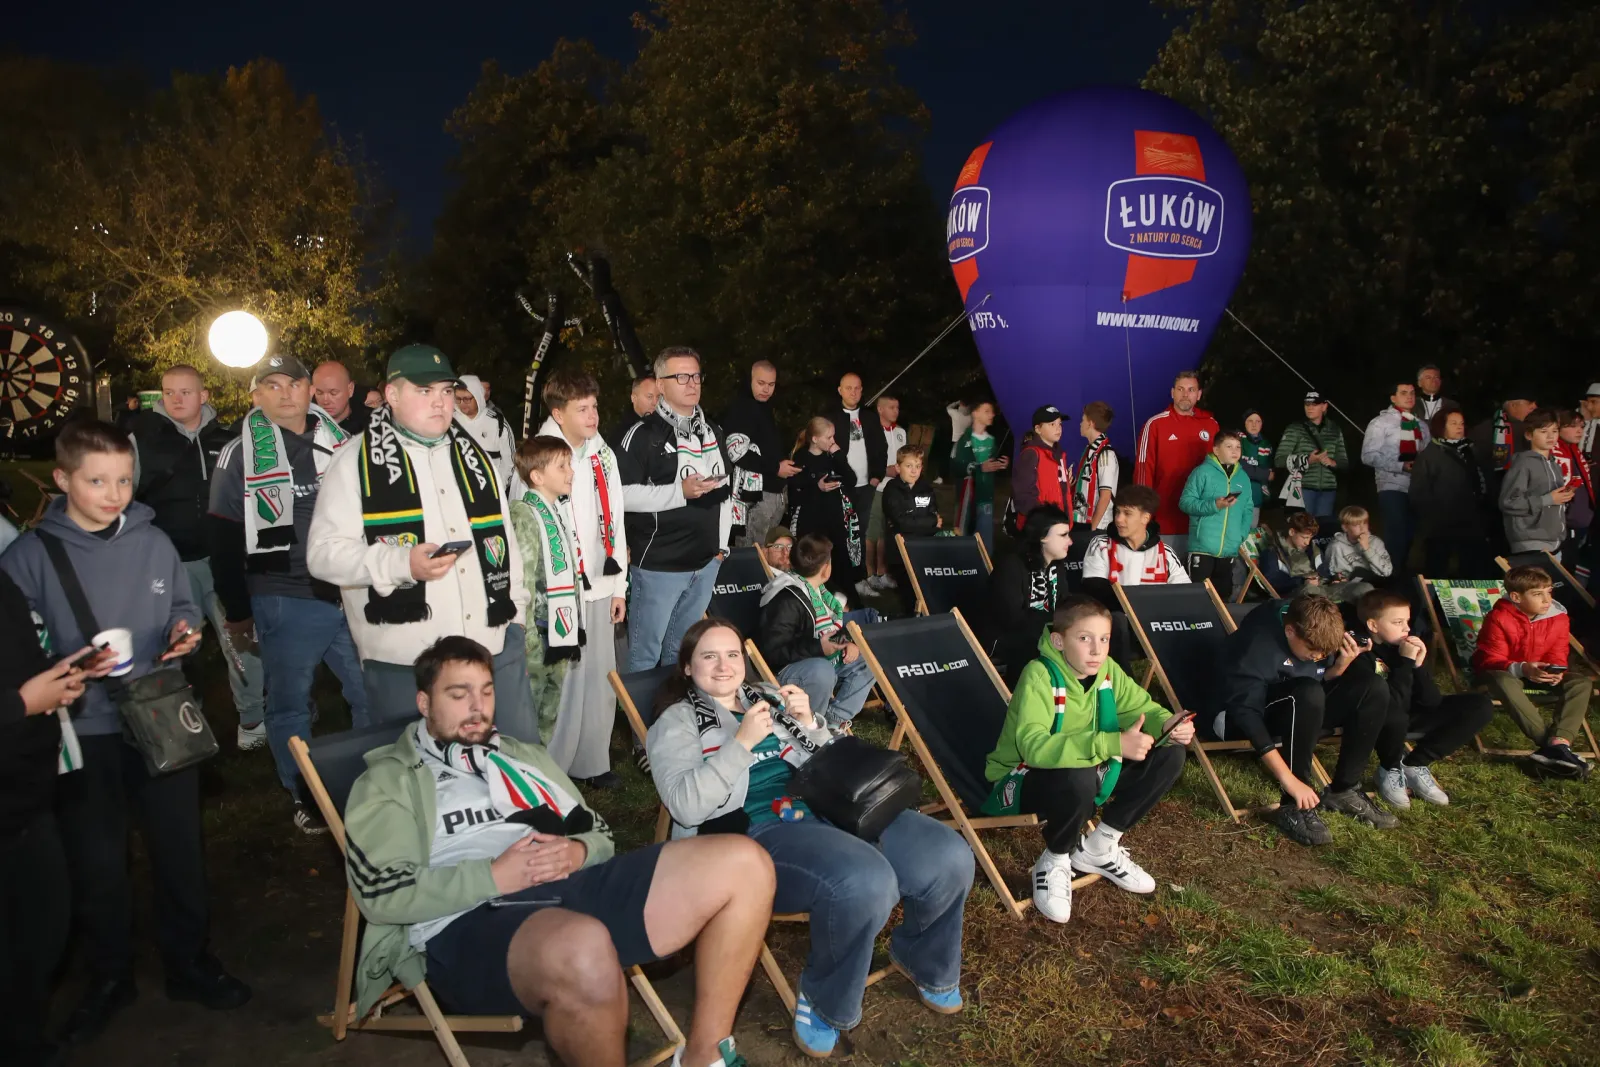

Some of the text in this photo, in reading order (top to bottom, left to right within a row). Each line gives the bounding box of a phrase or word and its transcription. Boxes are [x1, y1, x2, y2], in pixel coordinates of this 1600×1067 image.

[1120, 192, 1216, 235] ŁUKÓW
[1129, 232, 1203, 249] Z NATURY OD SERCA
[24, 317, 31, 327] 1
[975, 312, 996, 329] 1973
[1097, 311, 1200, 333] WWW.ZMLUKOW.PL
[38, 325, 54, 339] 18
[56, 341, 66, 350] 4
[65, 355, 77, 370] 13
[64, 389, 78, 403] 10
[44, 419, 54, 429] 2
[23, 426, 37, 437] 17
